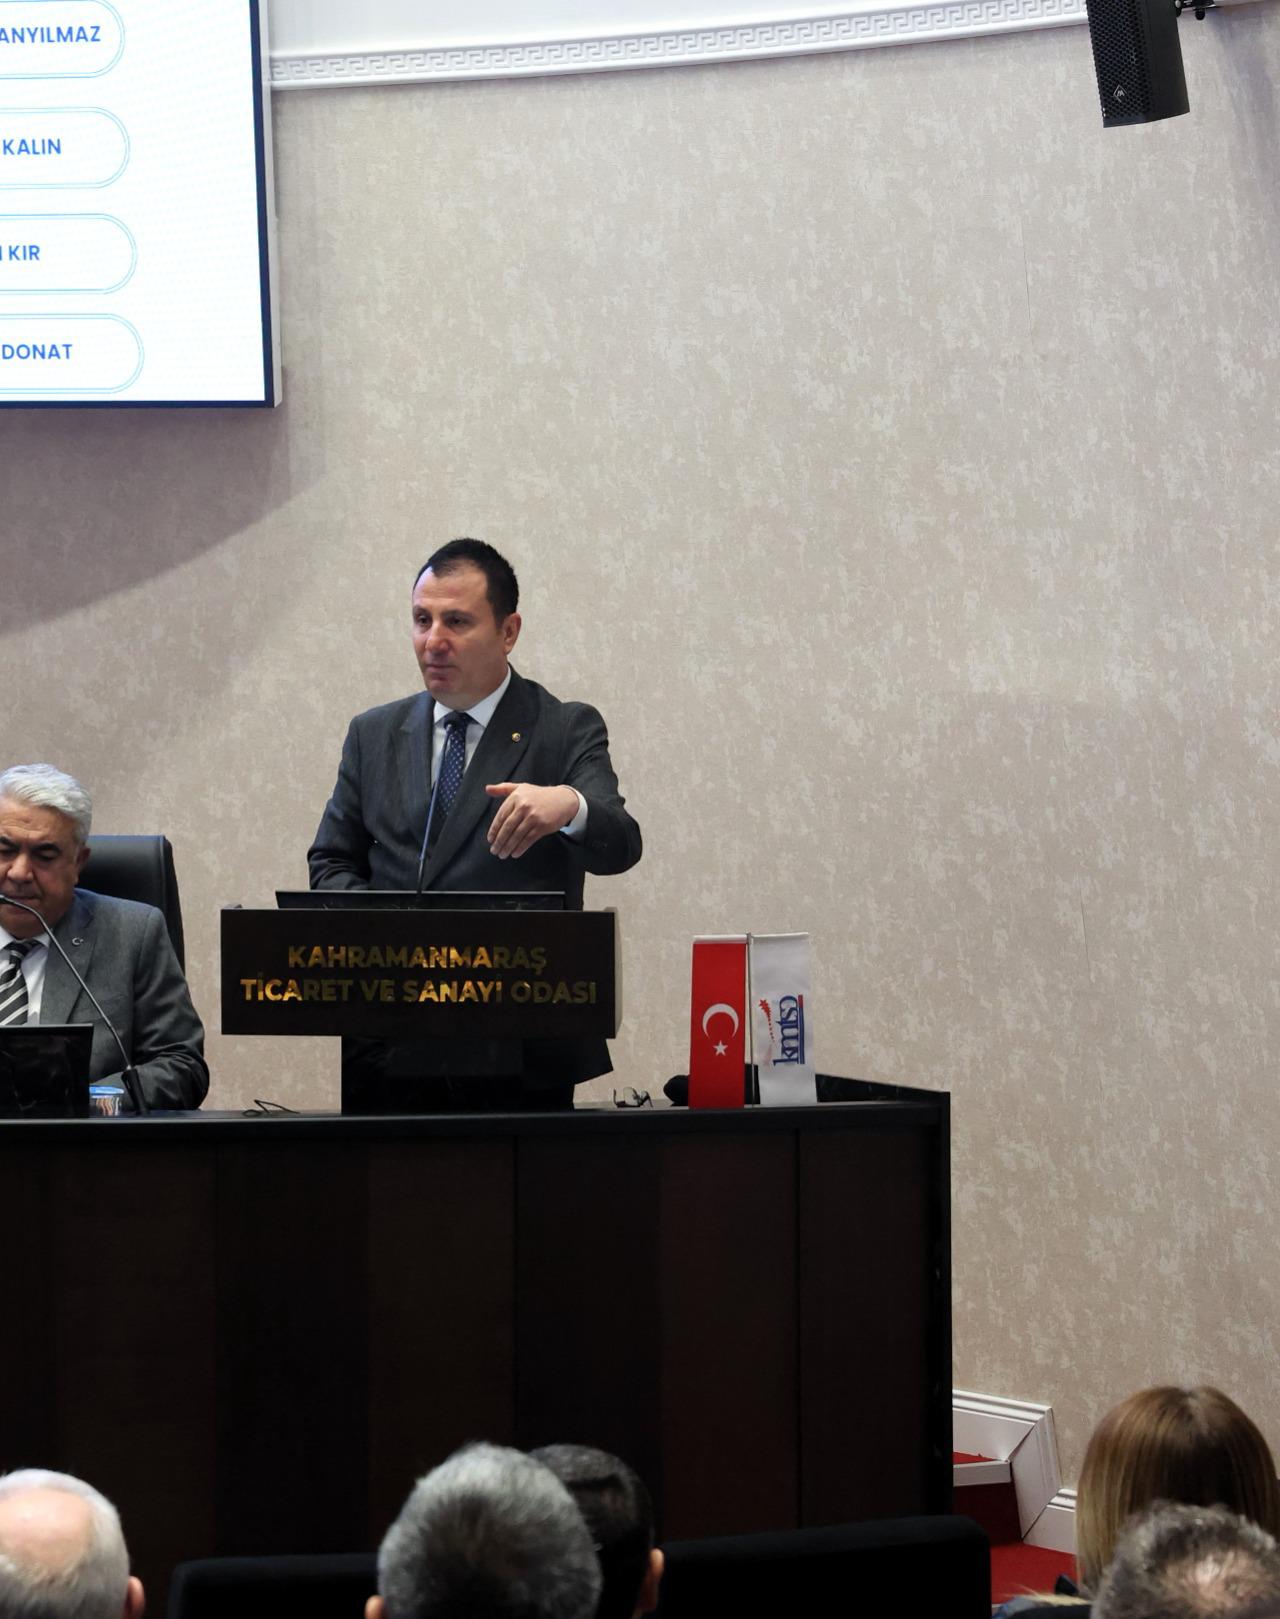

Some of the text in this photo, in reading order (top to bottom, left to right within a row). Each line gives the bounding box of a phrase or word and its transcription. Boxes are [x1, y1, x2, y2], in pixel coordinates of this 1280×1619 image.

[2, 138, 62, 156] KALIN
[8, 244, 41, 261] KIR
[1, 343, 73, 360] DONAT
[287, 945, 548, 976] KAHRAMANMARAŞ
[239, 971, 597, 1005] TİCARET VE SANAYİ ODASI
